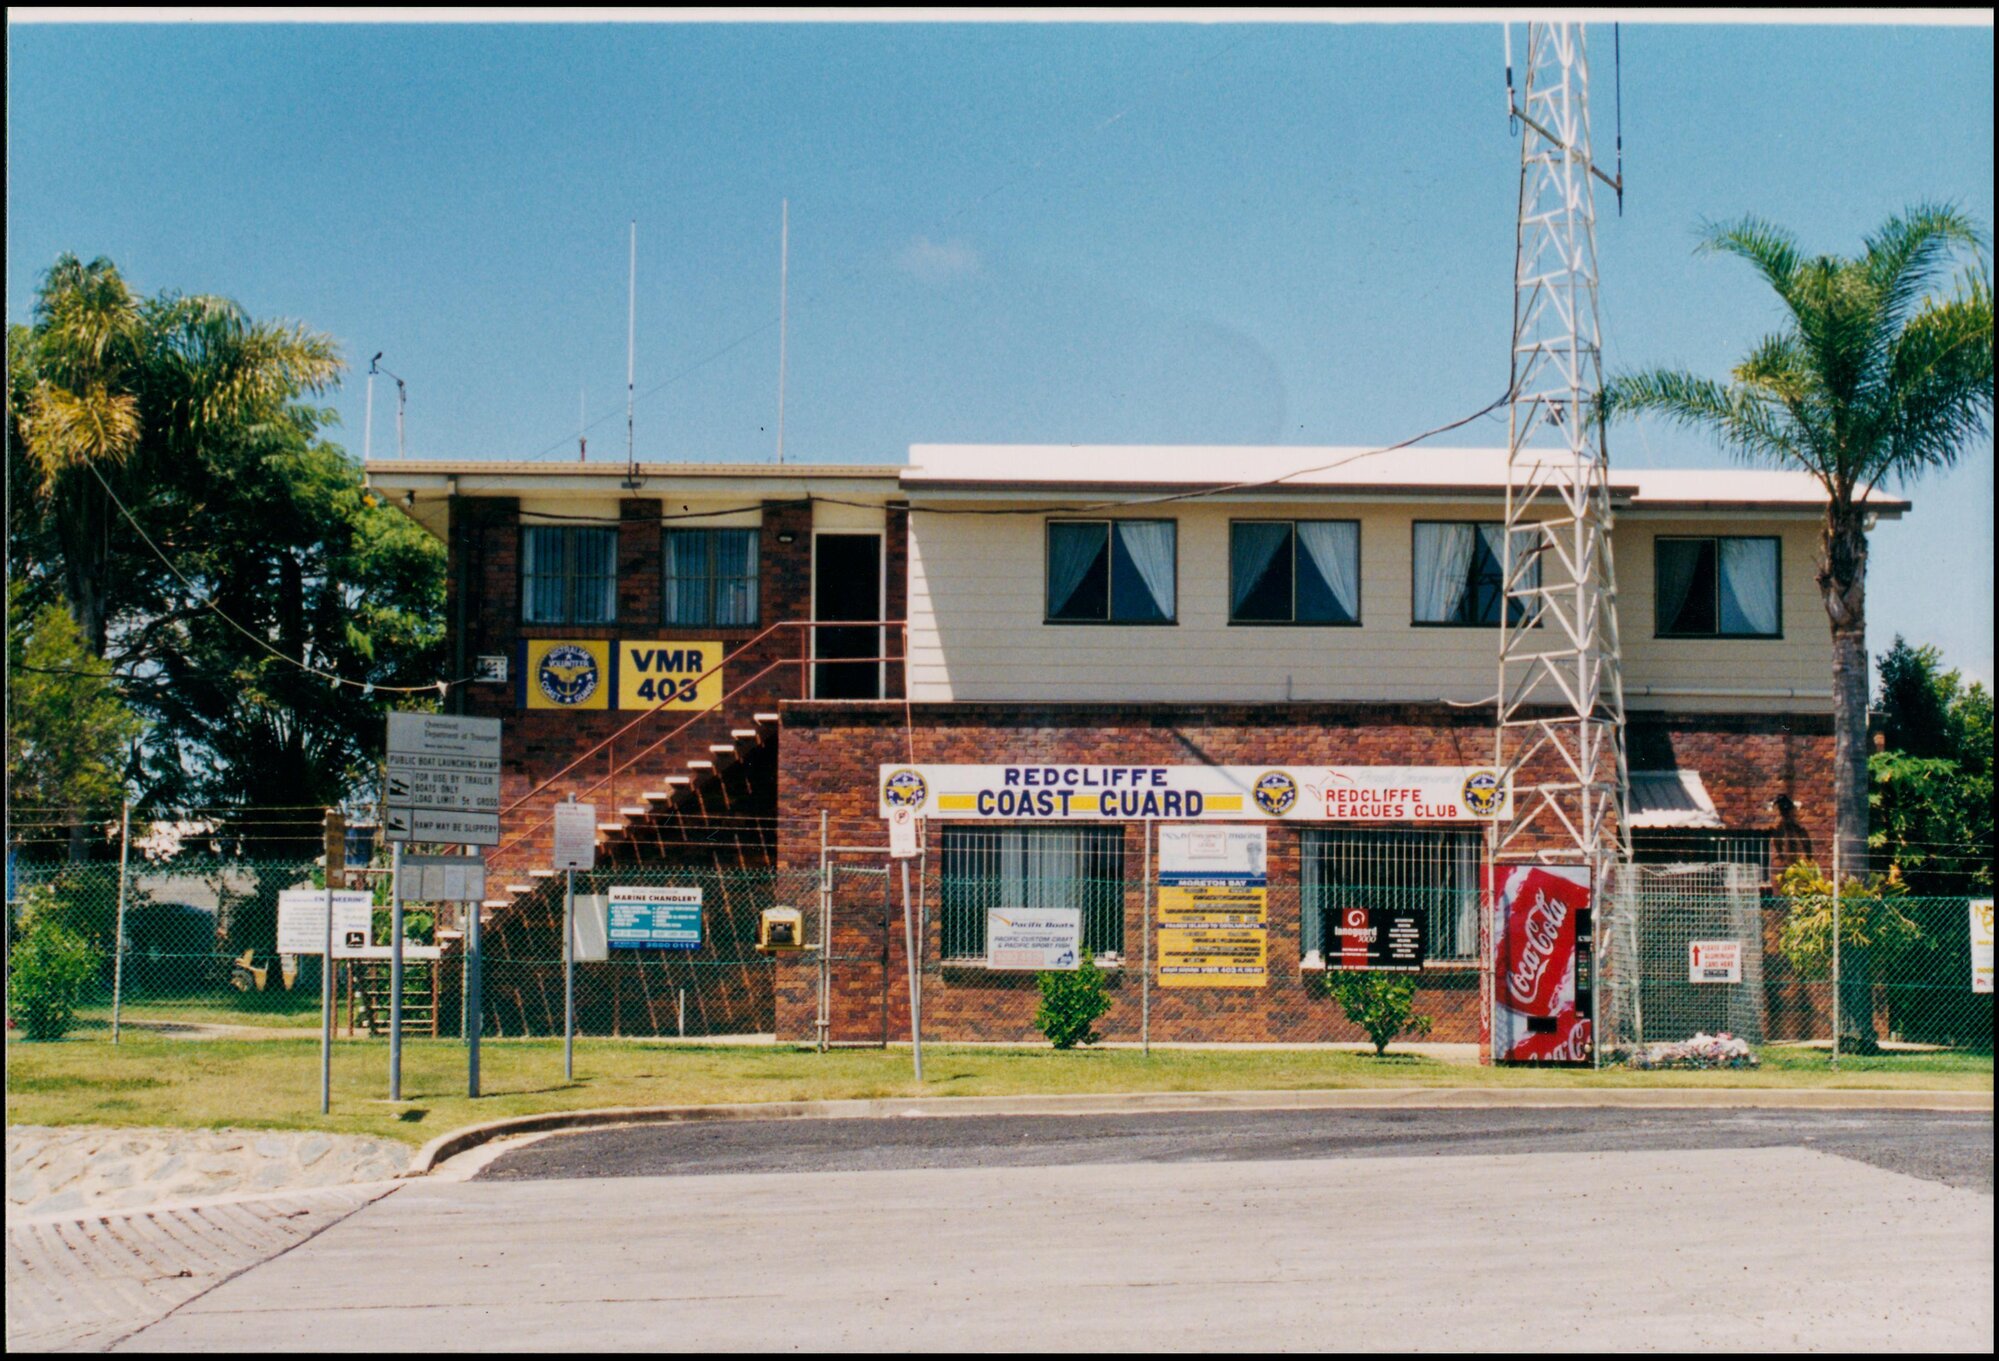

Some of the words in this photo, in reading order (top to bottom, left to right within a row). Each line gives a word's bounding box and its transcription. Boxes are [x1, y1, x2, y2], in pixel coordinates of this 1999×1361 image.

[631, 649, 703, 673] VMR
[637, 679, 698, 702] 403
[390, 755, 416, 765] PUBLIC
[418, 757, 436, 766] BOAT
[438, 758, 477, 768] LAUNCHING
[479, 760, 498, 769] RAMP
[415, 773, 429, 781] FOR
[433, 774, 447, 782] USE
[451, 775, 460, 783] BY
[465, 775, 493, 785] TRAILER
[1004, 768, 1168, 787] REDCLIFFE
[415, 784, 436, 793] BOATS
[441, 784, 459, 793] ONLY
[1326, 789, 1422, 802] REDCLIFFE
[415, 795, 432, 803] LOAD
[437, 796, 455, 805] LIMIT
[477, 797, 498, 807] GROSS
[977, 790, 1074, 817] COAST
[1100, 790, 1203, 817] GUARD
[1415, 805, 1457, 817] CLUB
[415, 820, 433, 829] RAMP
[436, 822, 450, 831] MAY
[453, 823, 462, 831] BE
[464, 823, 498, 834] SLIPPERY
[1507, 888, 1568, 1004] Coca-Cola
